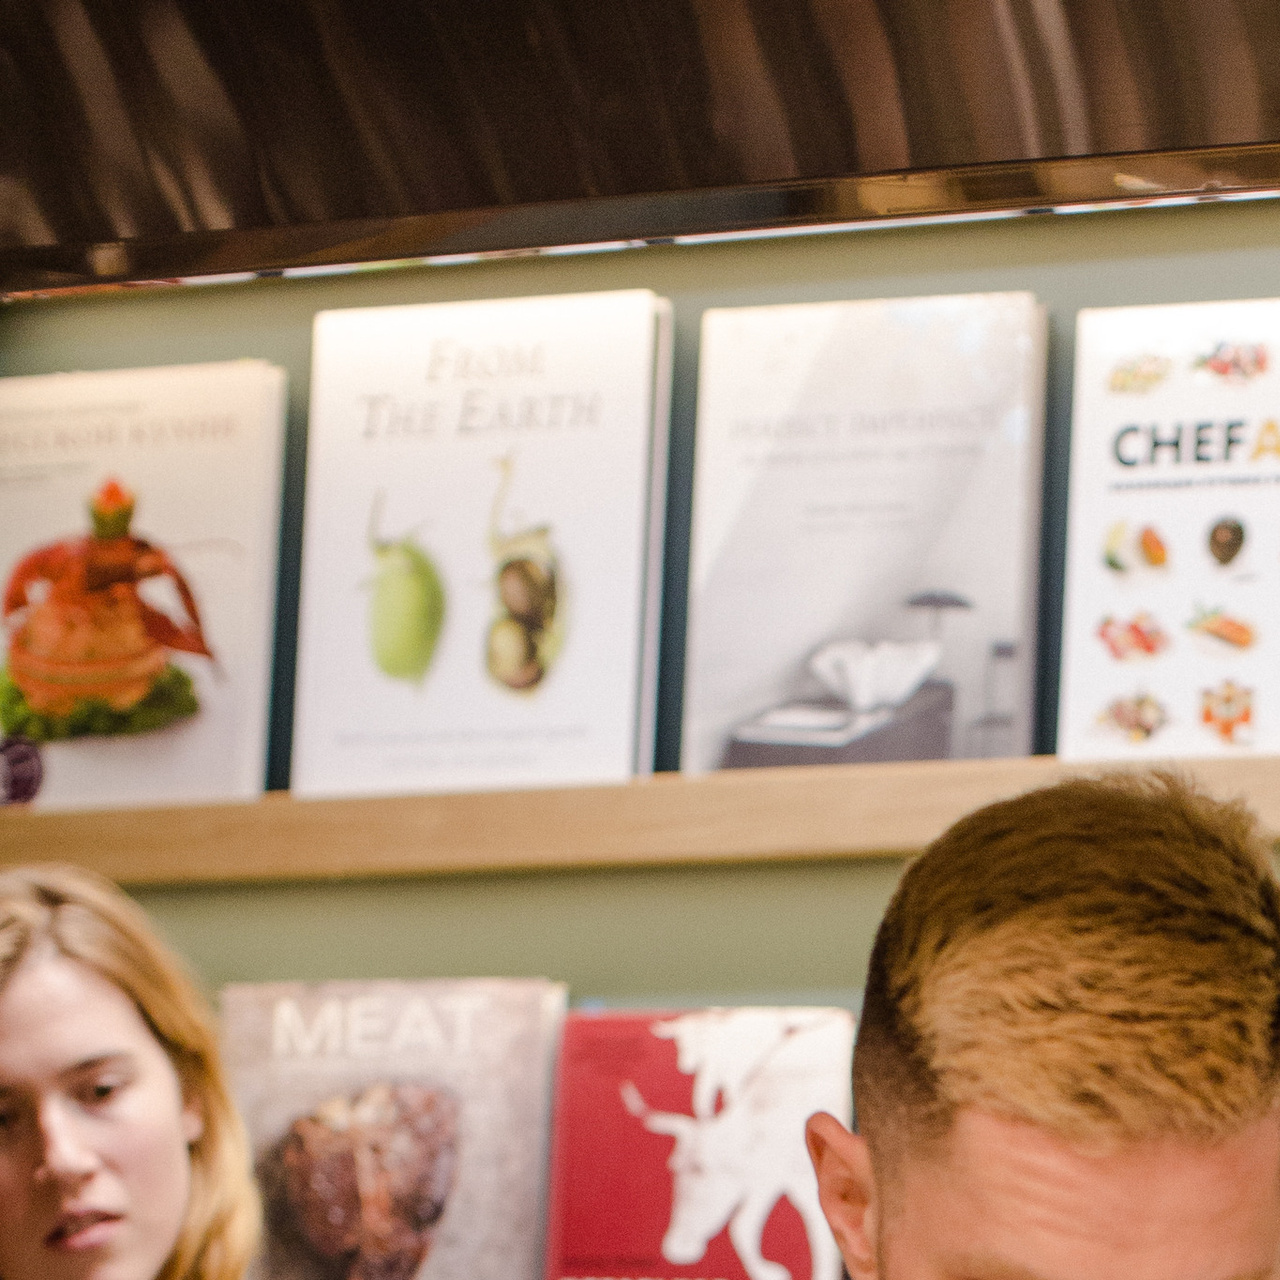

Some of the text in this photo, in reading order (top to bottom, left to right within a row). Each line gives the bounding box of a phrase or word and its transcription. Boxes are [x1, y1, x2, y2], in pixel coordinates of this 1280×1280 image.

[424, 337, 548, 383] FROM
[355, 387, 604, 440] THE EARTH
[271, 993, 478, 1058] MEAT
